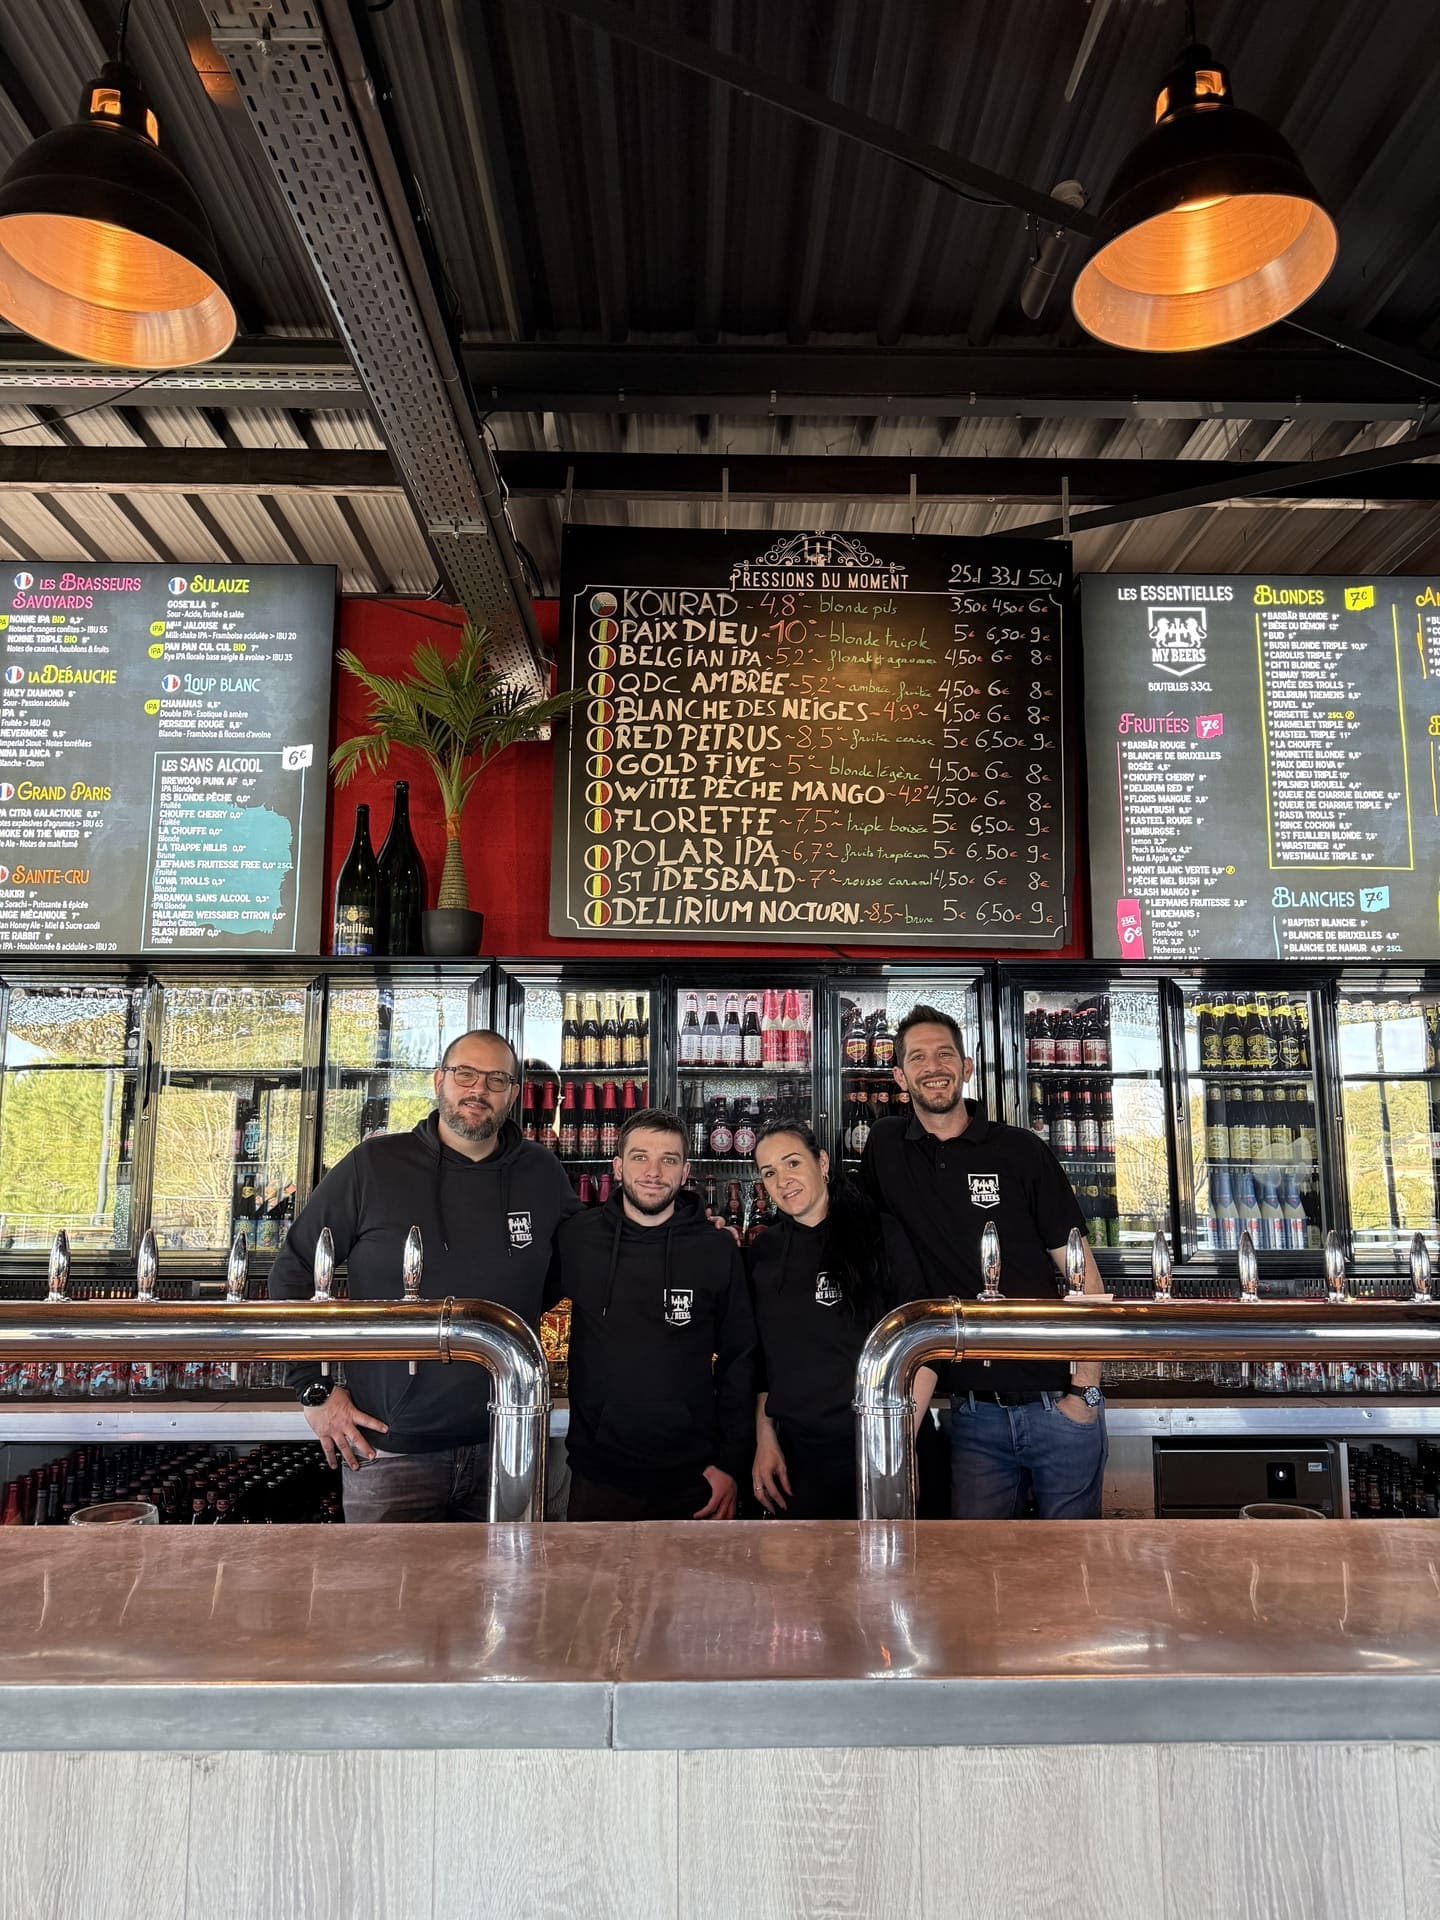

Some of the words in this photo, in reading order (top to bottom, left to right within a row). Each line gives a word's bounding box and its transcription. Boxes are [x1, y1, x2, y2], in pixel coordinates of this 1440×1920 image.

[40, 579, 55, 590] LES
[59, 573, 141, 591] BRASSEURS
[190, 575, 250, 593] SULAUZE
[730, 569, 815, 592] PRESSIONS
[822, 573, 840, 588] DU
[848, 573, 909, 590] MOMENT
[12, 591, 94, 609] SAVOYARDS
[1118, 588, 1137, 600] LES
[1140, 586, 1233, 601] ESSENTIELLES
[1254, 585, 1324, 605] BLONDES
[1350, 591, 1367, 606] 7€
[623, 590, 738, 618] KONRAD
[820, 594, 868, 615] blonde
[873, 598, 897, 620] pils
[52, 616, 65, 624] BIO
[621, 618, 678, 644] PAIX
[683, 618, 758, 647] DIEU
[830, 621, 879, 648] blonde
[619, 645, 723, 669] BELGIAN
[731, 647, 762, 667] IPA
[1152, 648, 1169, 662] MY
[1171, 648, 1206, 662] BEERS
[28, 672, 40, 684] LA
[41, 665, 118, 684] DÉBAUCHE
[184, 673, 217, 695] LOUP
[220, 678, 261, 692] BLANC
[691, 667, 790, 695] AMBRÉE
[615, 697, 732, 724] BLANCHE
[736, 700, 776, 718] DES
[782, 698, 870, 722] NEIGES
[1118, 711, 1190, 733] FRUITÉES
[1201, 719, 1219, 736] 7€
[615, 725, 672, 750] RED
[678, 723, 782, 752] PETRUS
[162, 760, 178, 772] LES
[180, 758, 213, 772] SANS
[217, 758, 264, 773] ALCOOL
[288, 750, 307, 765] 6€
[616, 753, 697, 776] GOLD
[705, 752, 766, 777] FIVE
[830, 755, 873, 776] blonde
[17, 781, 66, 801] GRAND
[69, 782, 111, 801] PARIS
[615, 778, 696, 802] WITTE
[701, 775, 783, 801] PÊCHE
[792, 781, 885, 804] MANGO
[34, 809, 82, 818] GALACTIQUE
[614, 805, 777, 836] FLOREFFE
[171, 827, 207, 835] CHOUFFE
[613, 837, 724, 871] POLAR
[735, 835, 779, 867] IPA
[12, 865, 90, 885] SAINTE-CRU
[617, 870, 642, 893] ST
[652, 867, 796, 893] IDESBALD
[1272, 886, 1355, 908] BLANCHES
[1365, 892, 1382, 909] 7€
[612, 895, 753, 925] DELIRIUM
[1124, 927, 1142, 943] 6€
